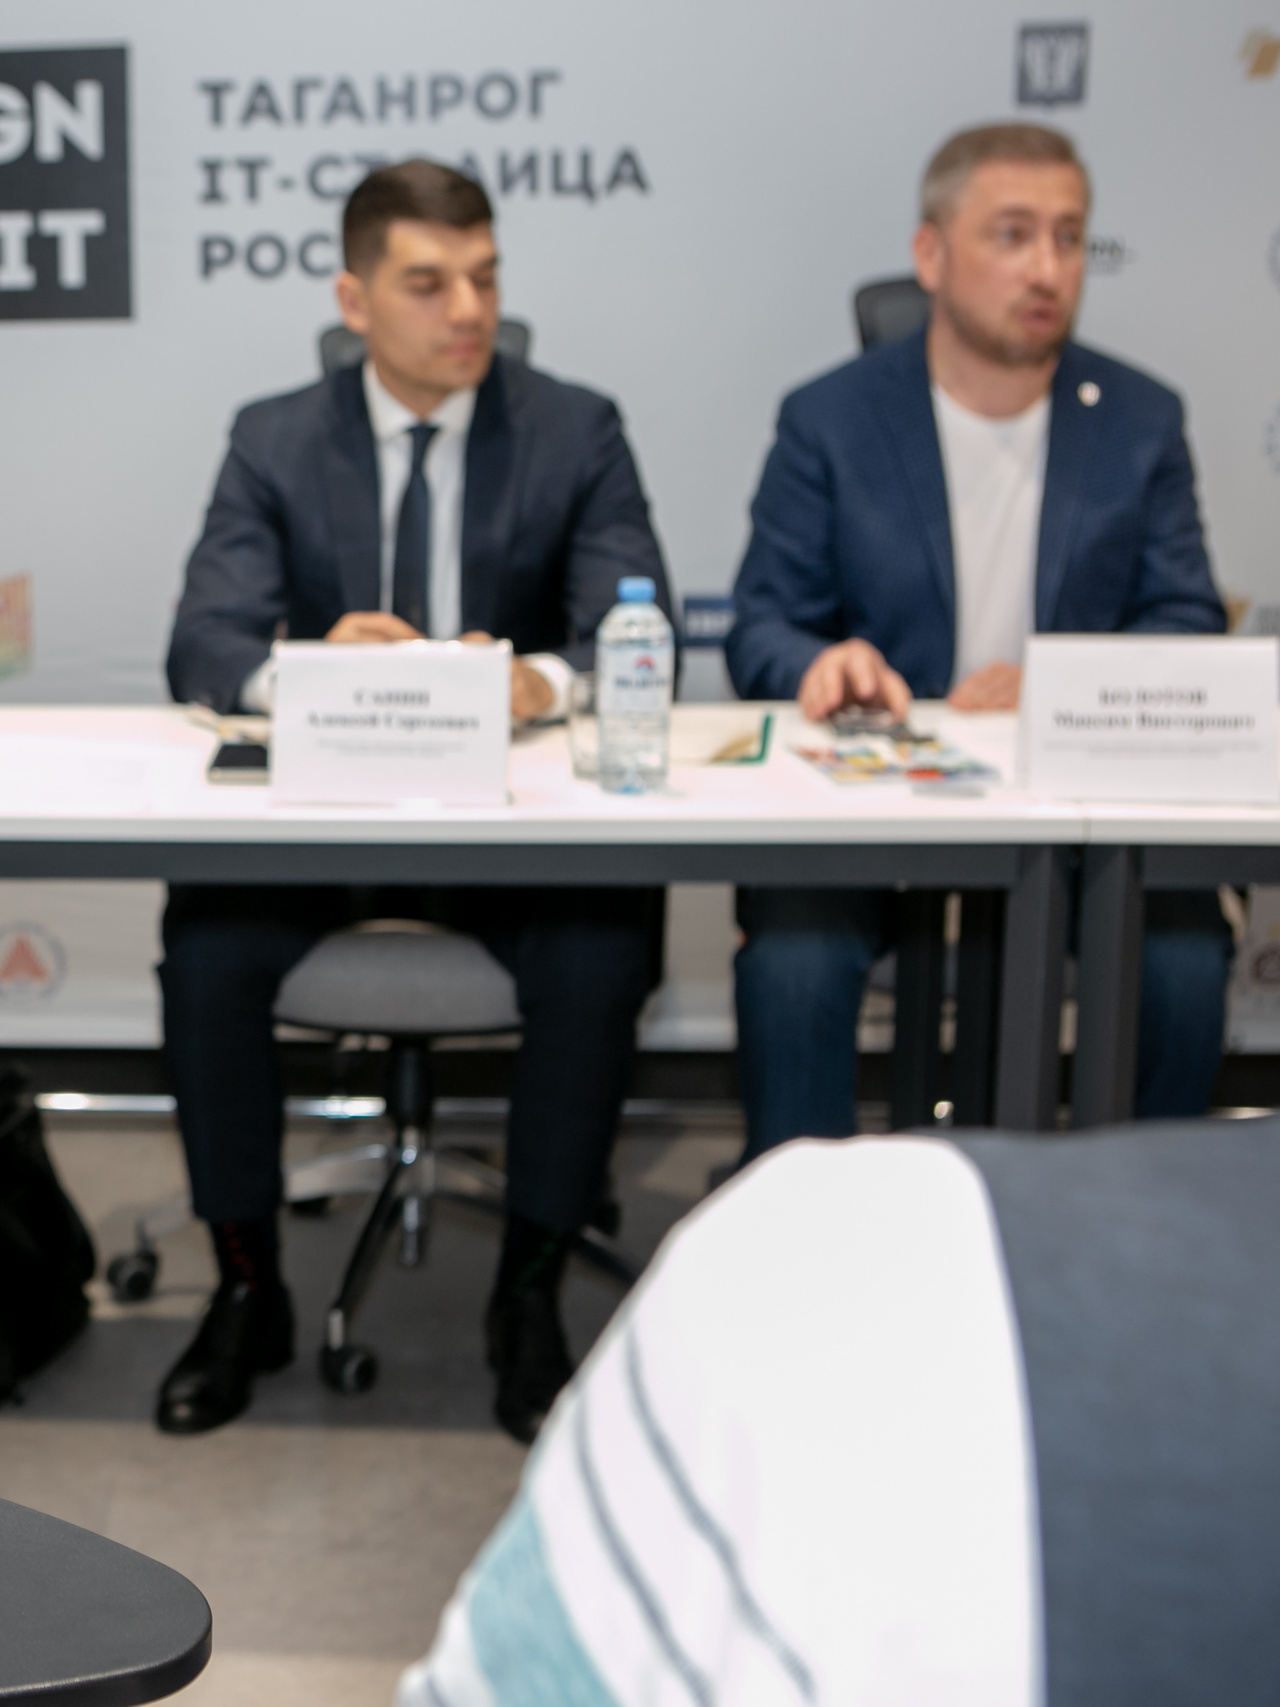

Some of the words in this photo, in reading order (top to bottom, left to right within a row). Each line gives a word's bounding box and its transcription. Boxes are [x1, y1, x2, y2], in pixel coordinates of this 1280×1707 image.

[198, 69, 560, 127] ТАГАНРОГ
[198, 146, 650, 206] IT-СЛИЦА
[198, 231, 344, 281] РОС
